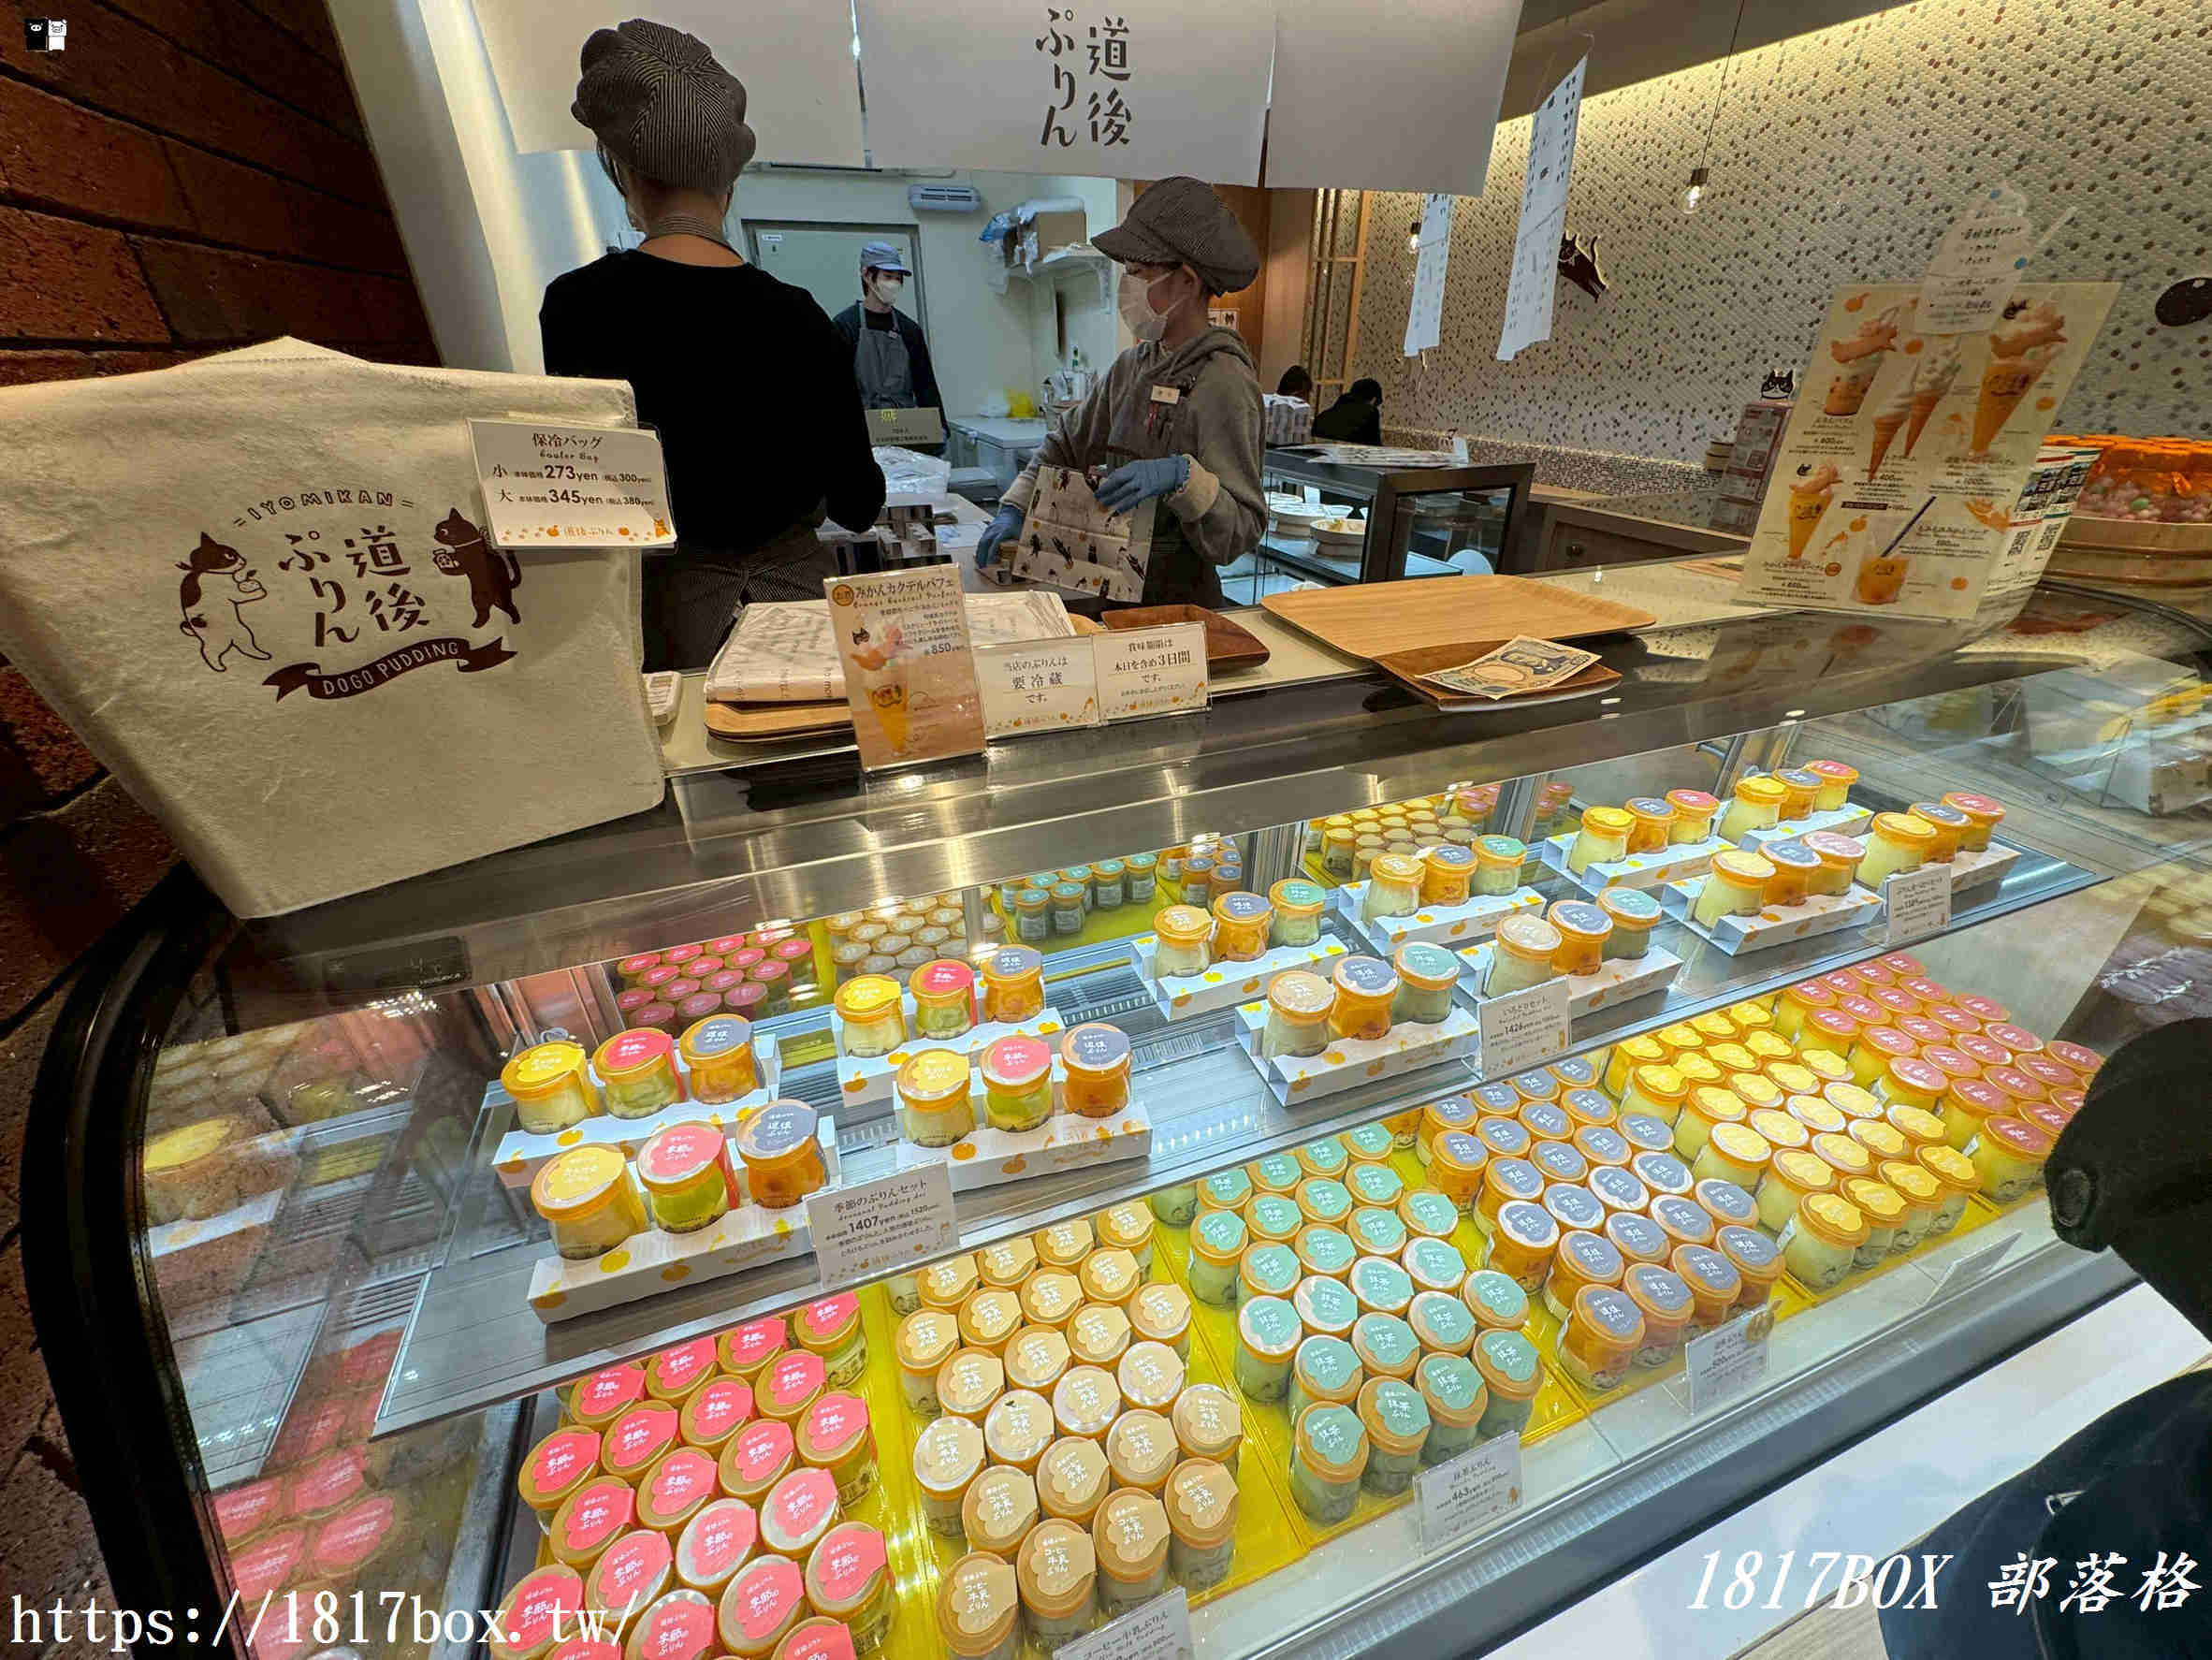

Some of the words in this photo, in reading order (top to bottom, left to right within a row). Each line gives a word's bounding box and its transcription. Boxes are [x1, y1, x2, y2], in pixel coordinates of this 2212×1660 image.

[1036, 7, 1077, 147] ぷりん
[1086, 16, 1132, 147] 道後
[532, 432, 604, 449] 保冷バッグ
[493, 463, 508, 479] 小
[544, 464, 599, 483] 273yen
[247, 490, 395, 521] IYOMIKAN
[499, 488, 515, 502] 大
[547, 488, 604, 506] 345yen
[278, 530, 360, 647] ぷりん
[344, 524, 429, 634] 道後
[853, 576, 954, 600] みかんカクテルパフェ
[321, 670, 375, 697] DOGO
[377, 640, 461, 680] PUDDING
[1141, 672, 1162, 684] です。
[1011, 671, 1064, 690] 要冷蔵
[1025, 692, 1049, 705] です。
[848, 1211, 897, 1234] 1407yen
[614, 1558, 646, 1579] 季節の
[749, 1588, 780, 1610] 季節の
[658, 1626, 690, 1645] 季節の
